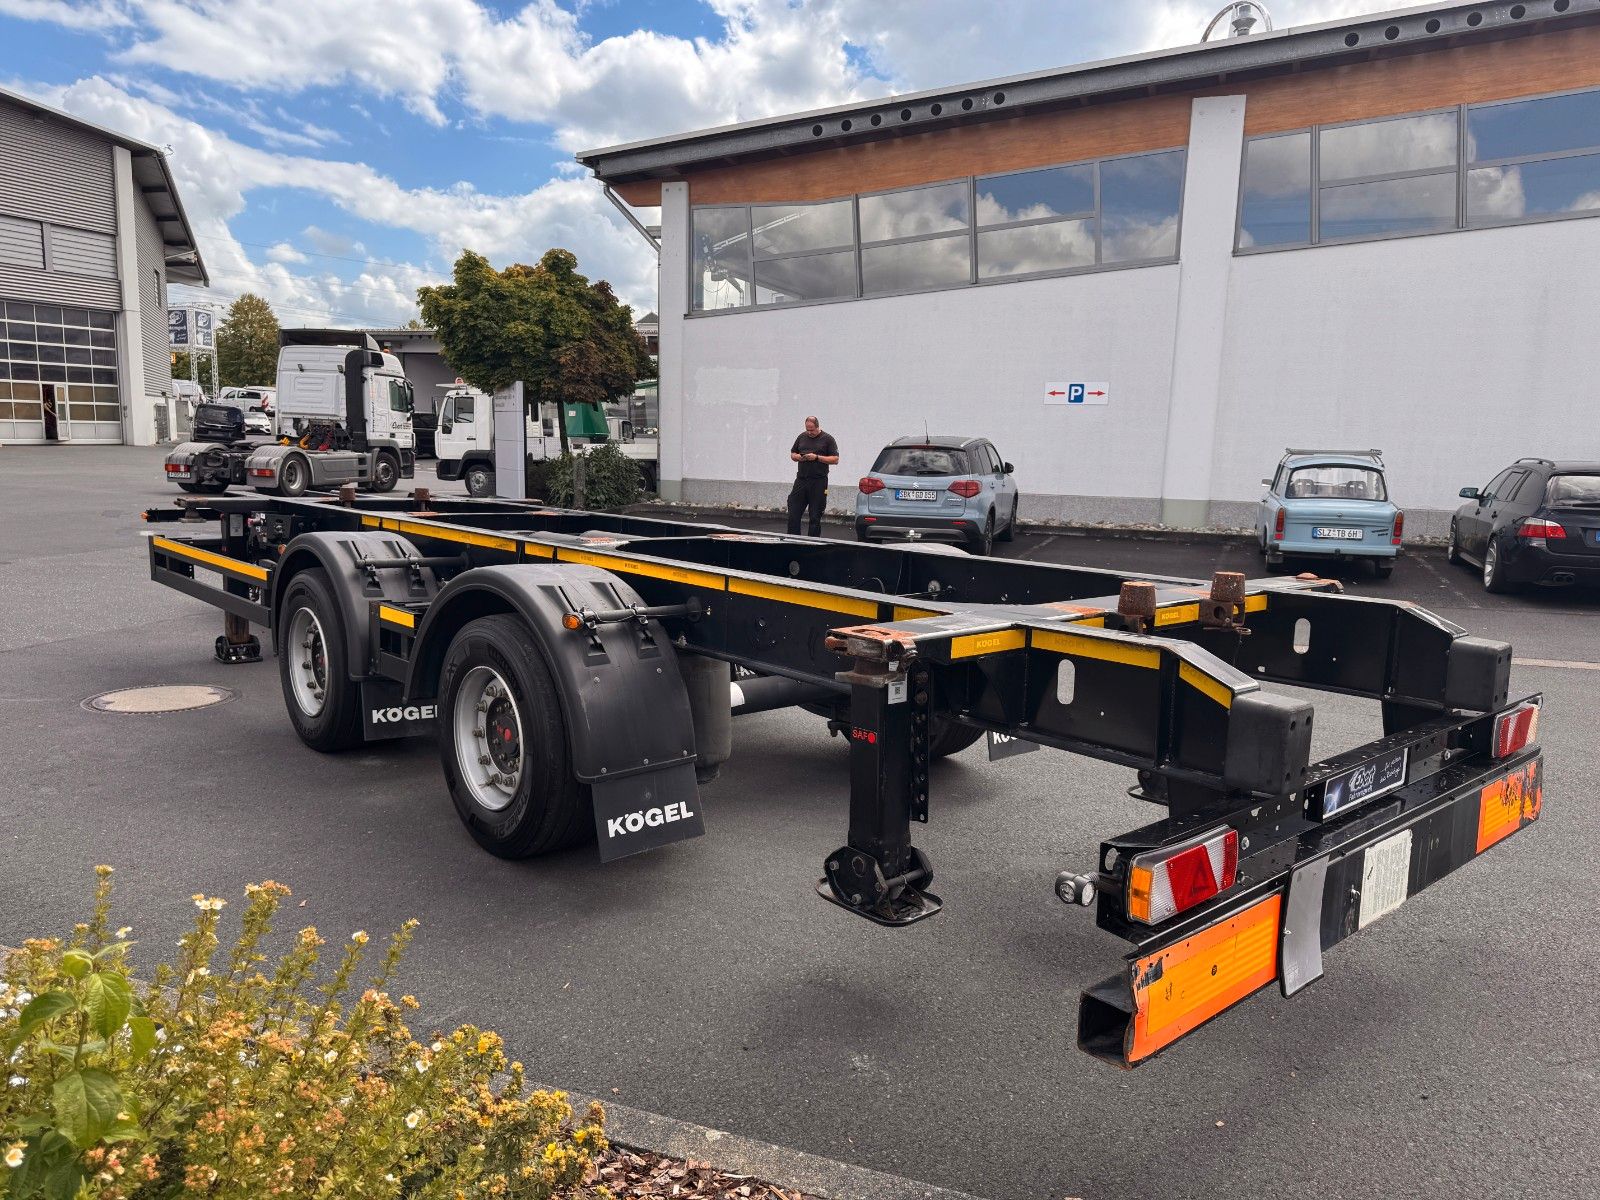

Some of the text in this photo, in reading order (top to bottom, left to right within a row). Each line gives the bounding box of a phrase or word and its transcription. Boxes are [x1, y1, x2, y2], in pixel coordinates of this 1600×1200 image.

[1070, 386, 1082, 400] P
[1317, 529, 1358, 538] SLZ TB 6H
[607, 800, 694, 838] KÖGEL
